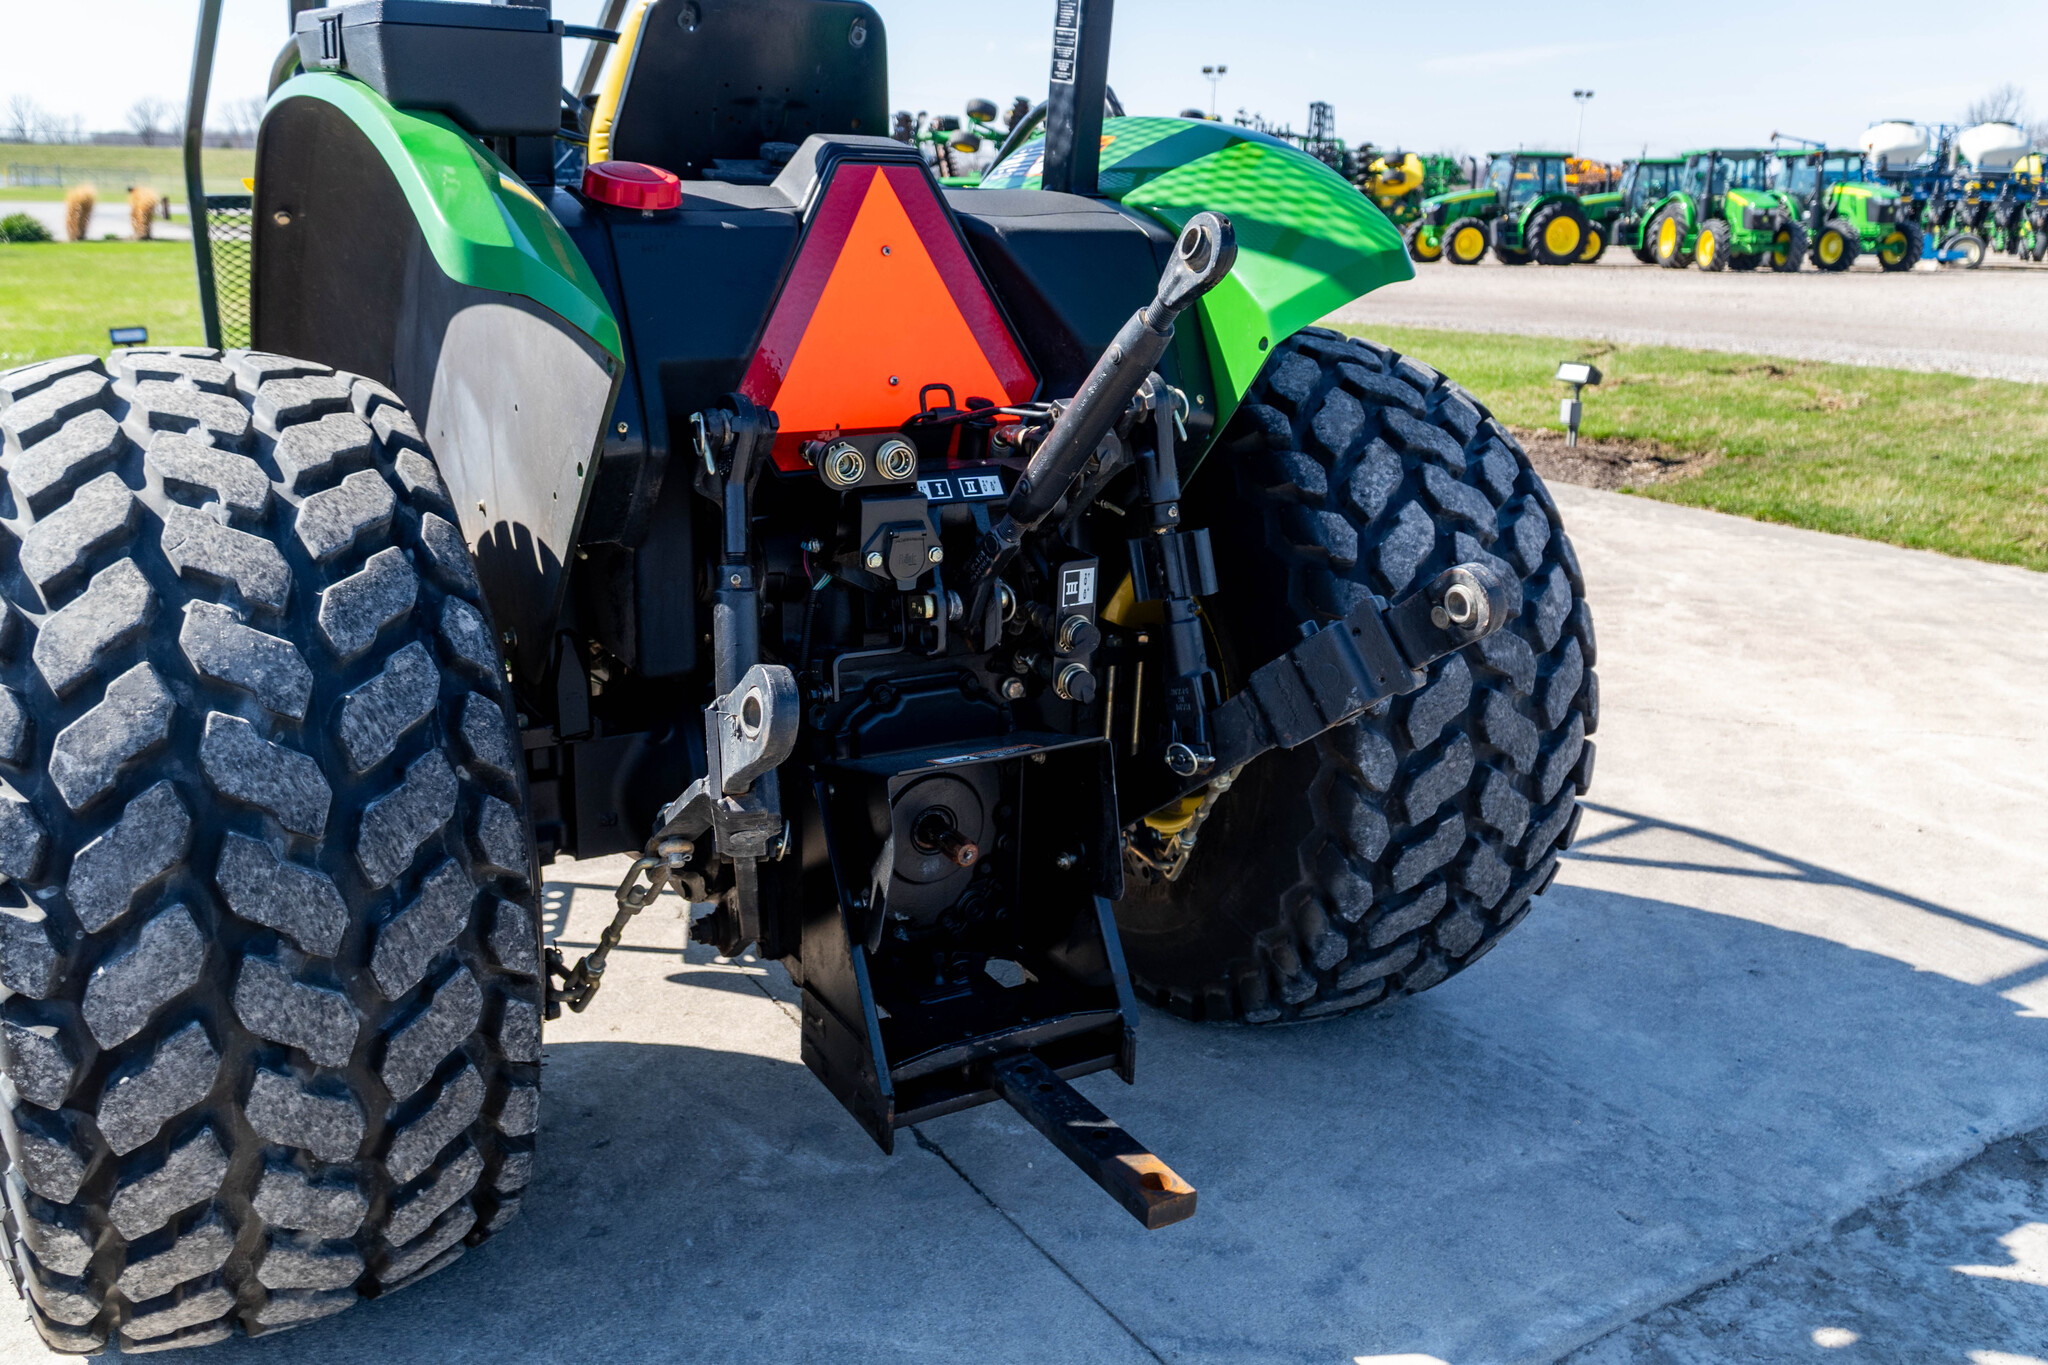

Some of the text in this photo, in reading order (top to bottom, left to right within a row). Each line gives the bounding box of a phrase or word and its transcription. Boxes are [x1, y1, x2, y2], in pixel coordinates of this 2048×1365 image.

[935, 483, 945, 495] I
[965, 481, 977, 493] II
[1066, 581, 1078, 595] III
